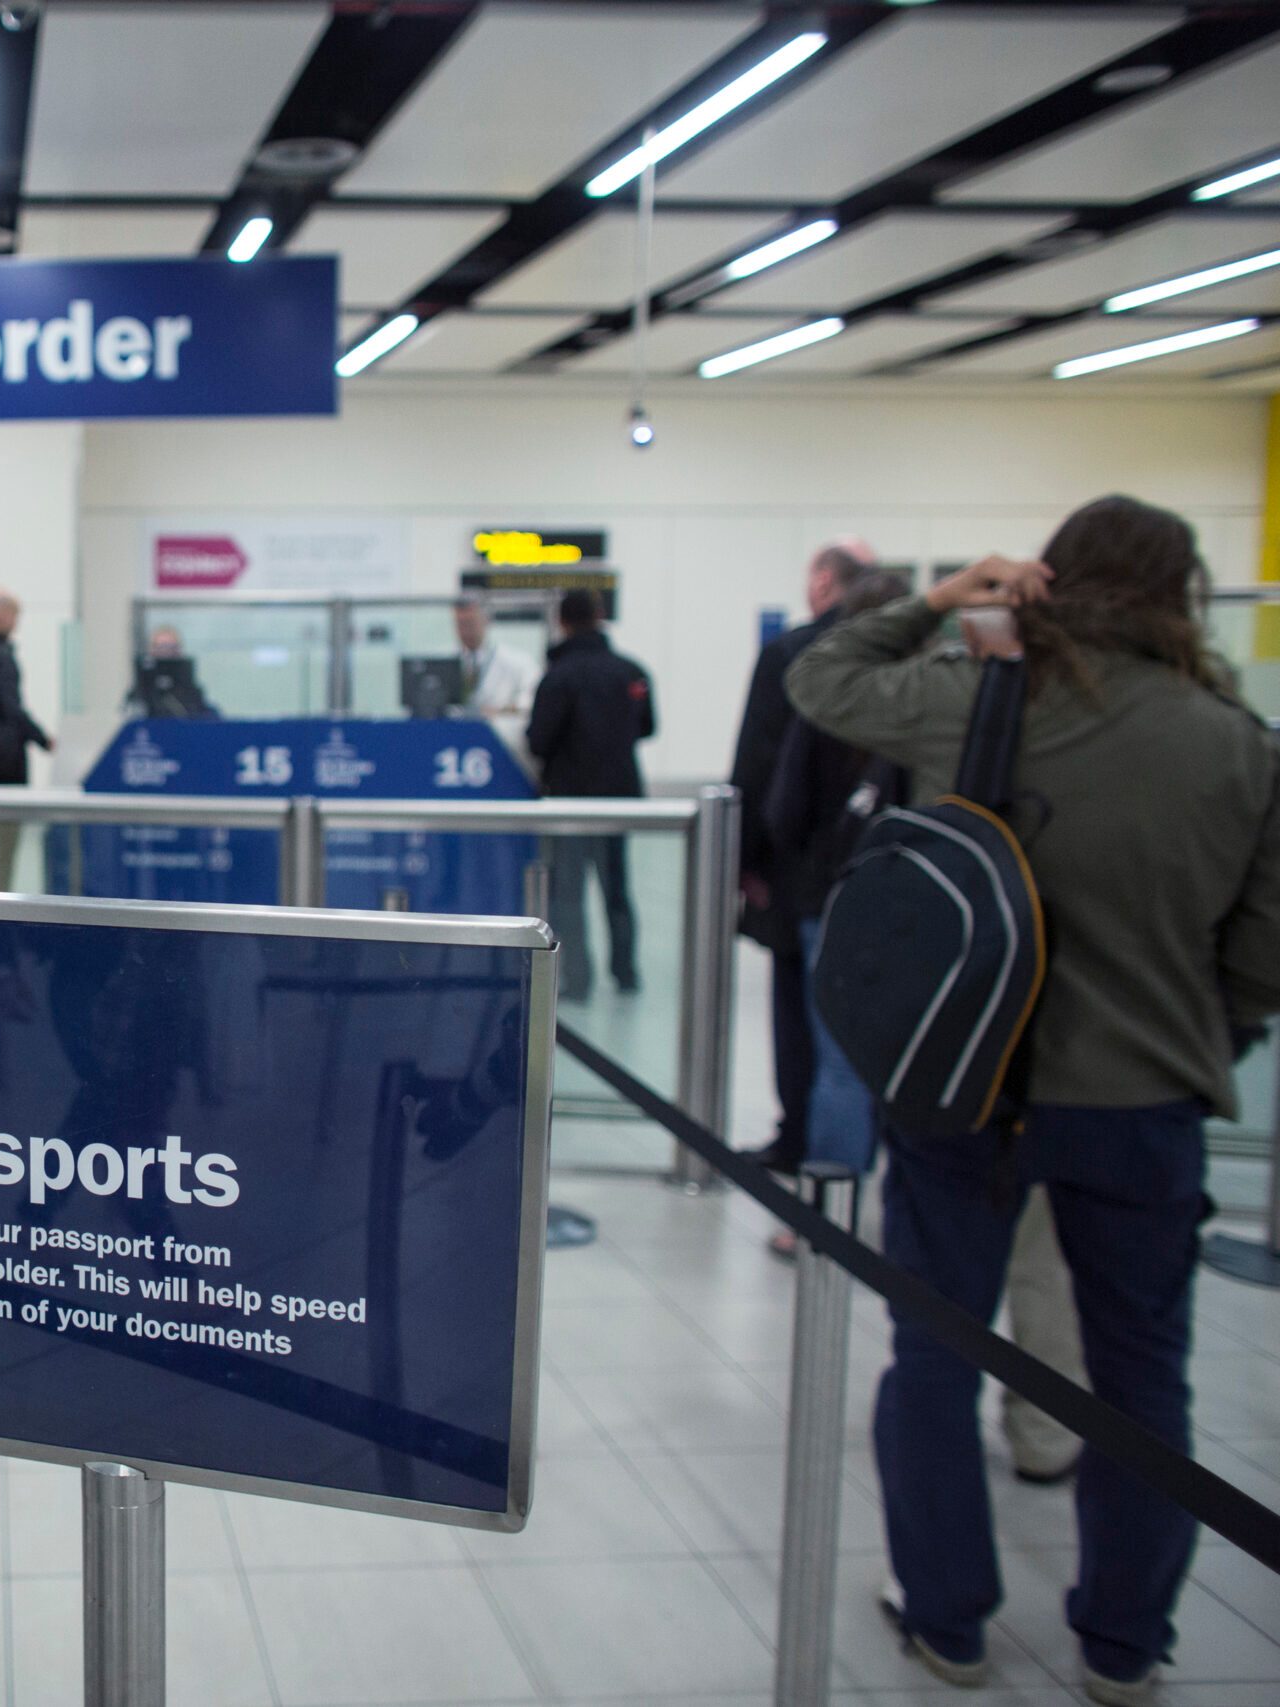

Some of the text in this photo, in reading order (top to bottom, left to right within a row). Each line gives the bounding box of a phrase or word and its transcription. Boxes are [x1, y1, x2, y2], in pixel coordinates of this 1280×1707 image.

[236, 746, 293, 785] 15
[435, 748, 493, 787] 16
[30, 1226, 155, 1260] passport
[162, 1236, 231, 1267] from
[73, 1264, 130, 1296] This
[138, 1277, 188, 1303] will
[198, 1279, 262, 1316] help
[270, 1294, 366, 1324] speed
[21, 1299, 49, 1324] of
[56, 1307, 118, 1333] your
[125, 1312, 292, 1355] documents
